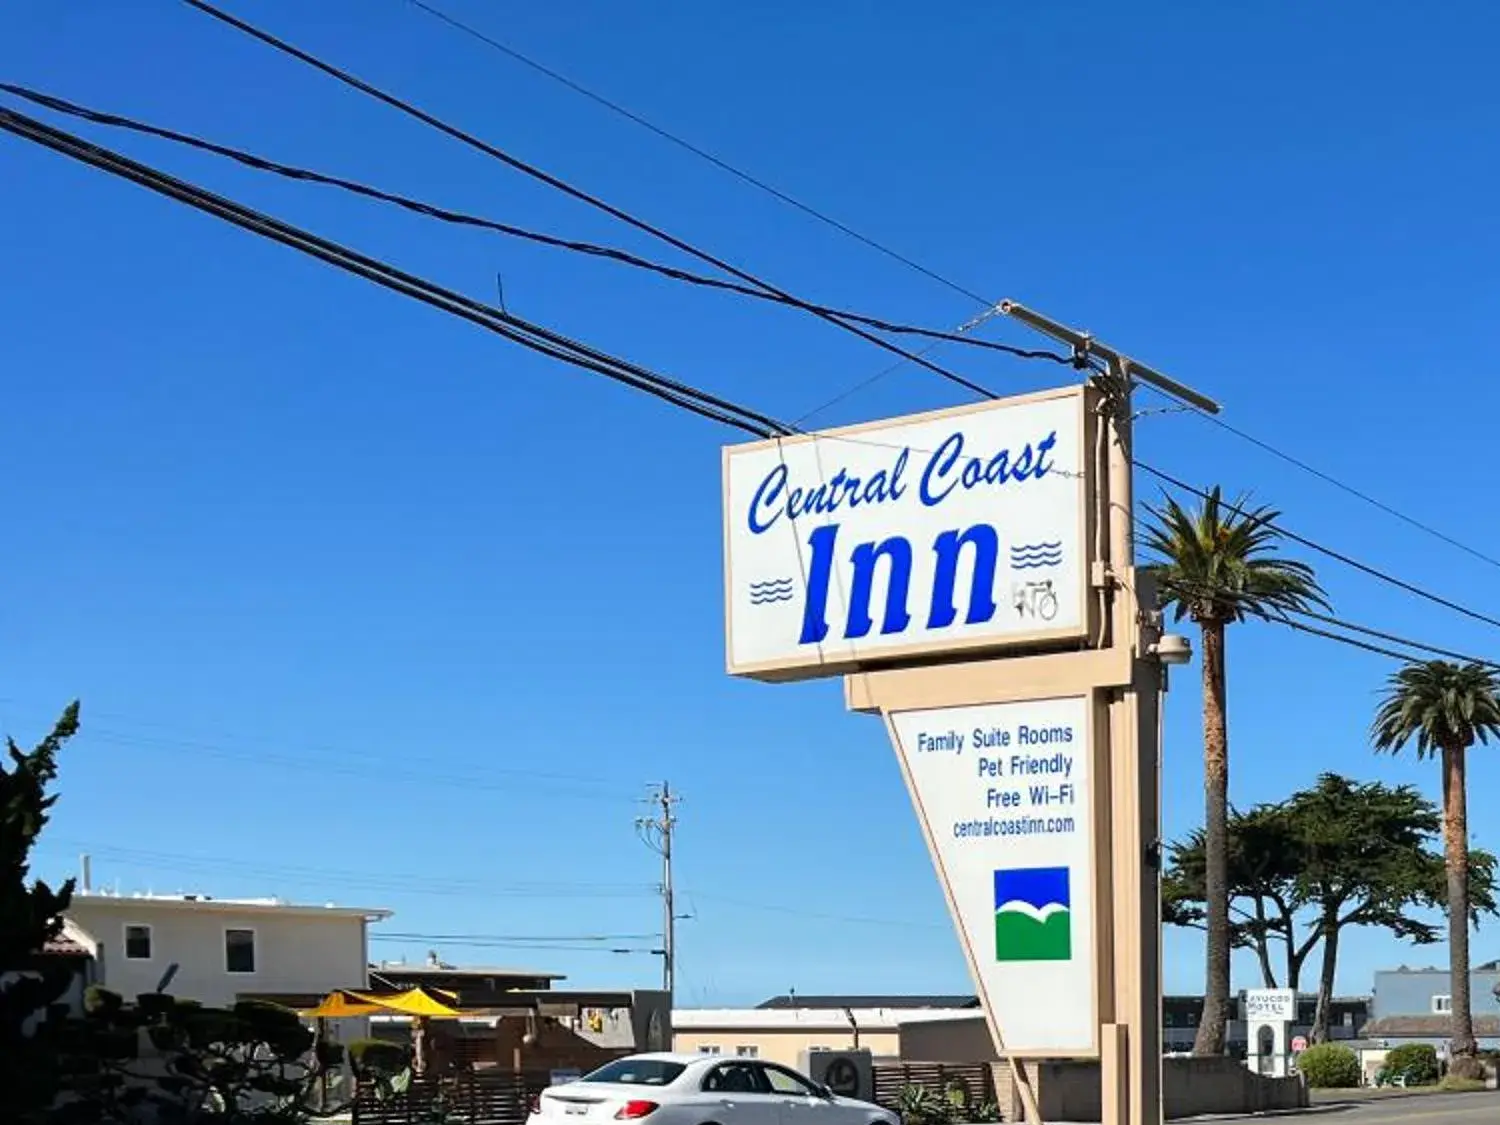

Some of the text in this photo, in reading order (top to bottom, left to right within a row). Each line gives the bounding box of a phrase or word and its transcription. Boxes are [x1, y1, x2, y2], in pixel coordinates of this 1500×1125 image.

[748, 431, 1056, 533] Central Coast
[798, 523, 999, 644] Inn
[917, 725, 1073, 754] Family Suite Rooms
[978, 754, 1073, 777] Pet Friendly
[987, 784, 1075, 808] Free Wi-Fi
[953, 815, 1075, 838] centralcoastinn.com
